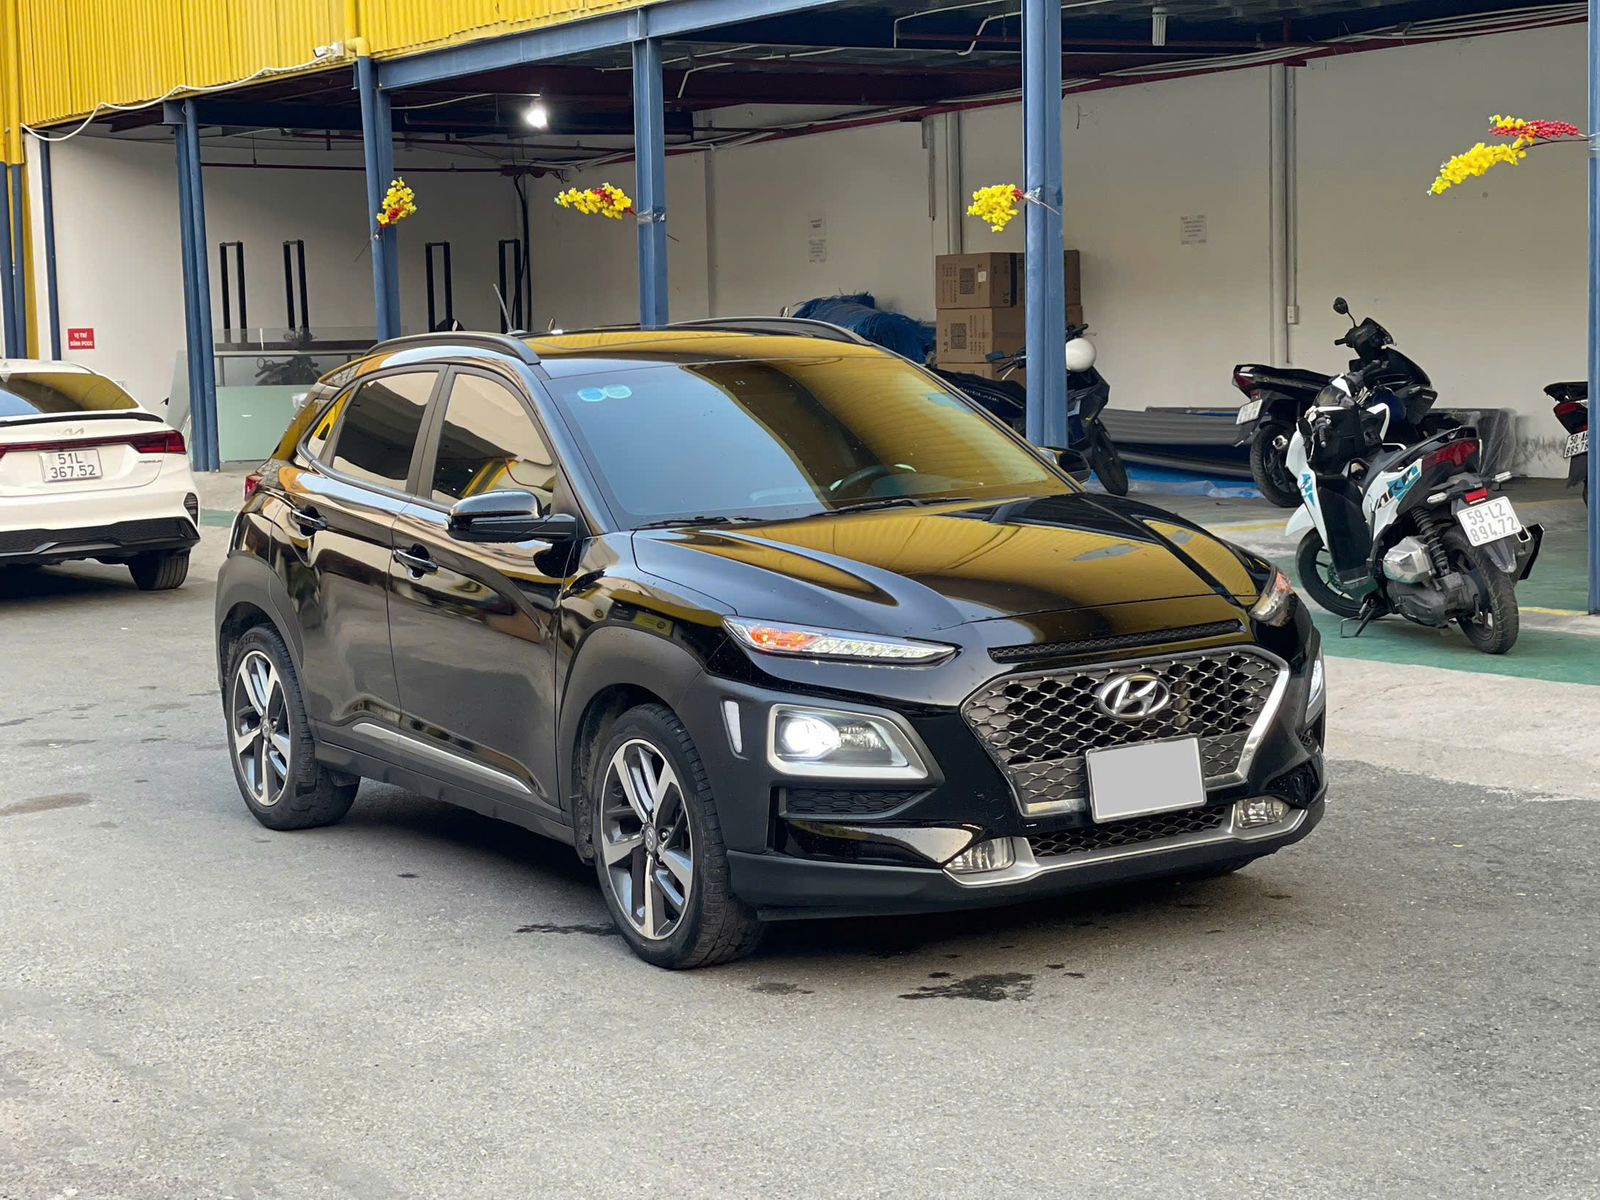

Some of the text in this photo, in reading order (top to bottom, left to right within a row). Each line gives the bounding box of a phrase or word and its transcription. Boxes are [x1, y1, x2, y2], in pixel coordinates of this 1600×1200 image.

[58, 452, 83, 466] 51L
[49, 464, 96, 479] 367.52
[1470, 516, 1518, 543] 894.72
